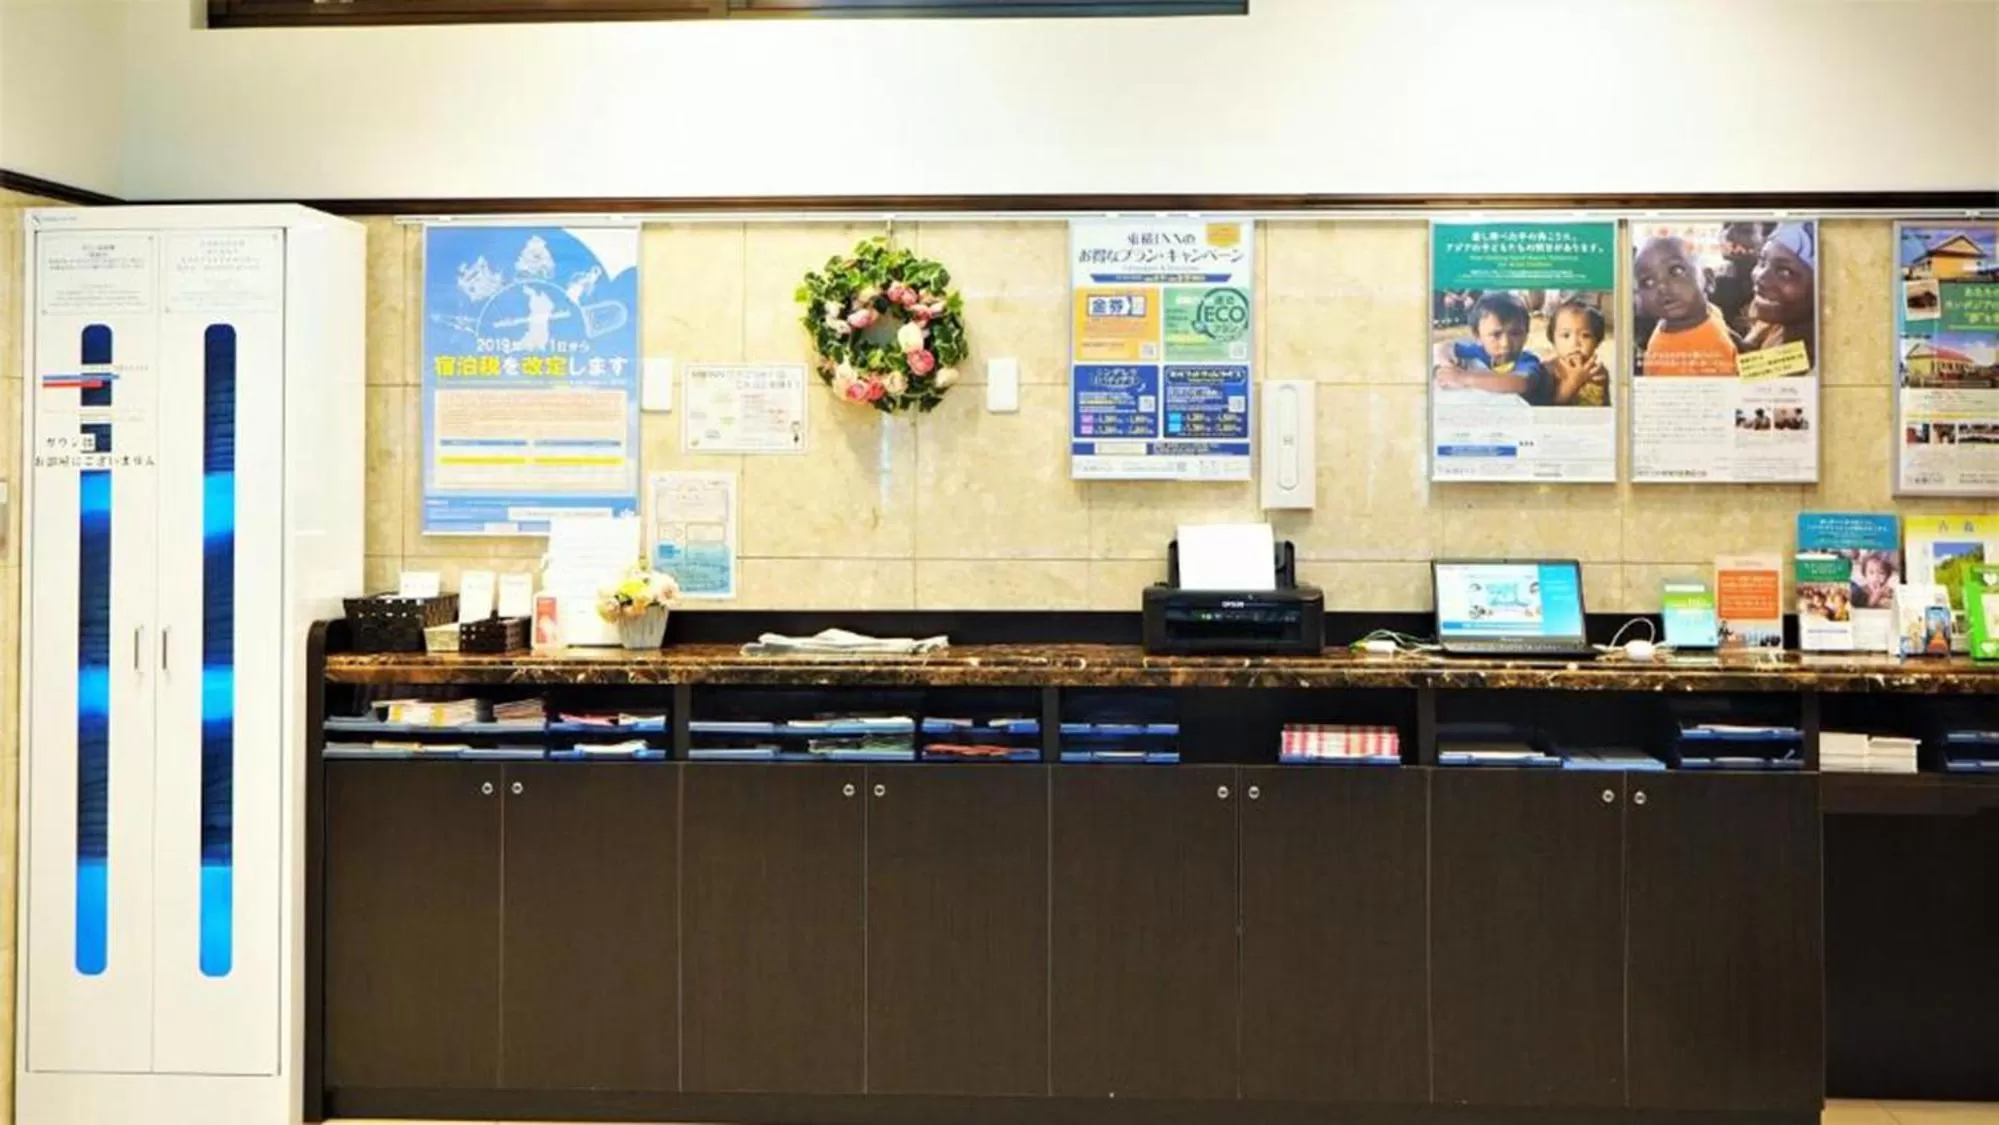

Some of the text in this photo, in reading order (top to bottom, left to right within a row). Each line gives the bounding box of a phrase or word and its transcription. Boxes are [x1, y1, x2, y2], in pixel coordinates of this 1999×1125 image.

[1204, 306, 1246, 322] ECO
[434, 355, 629, 377] 宿泊税を改定します
